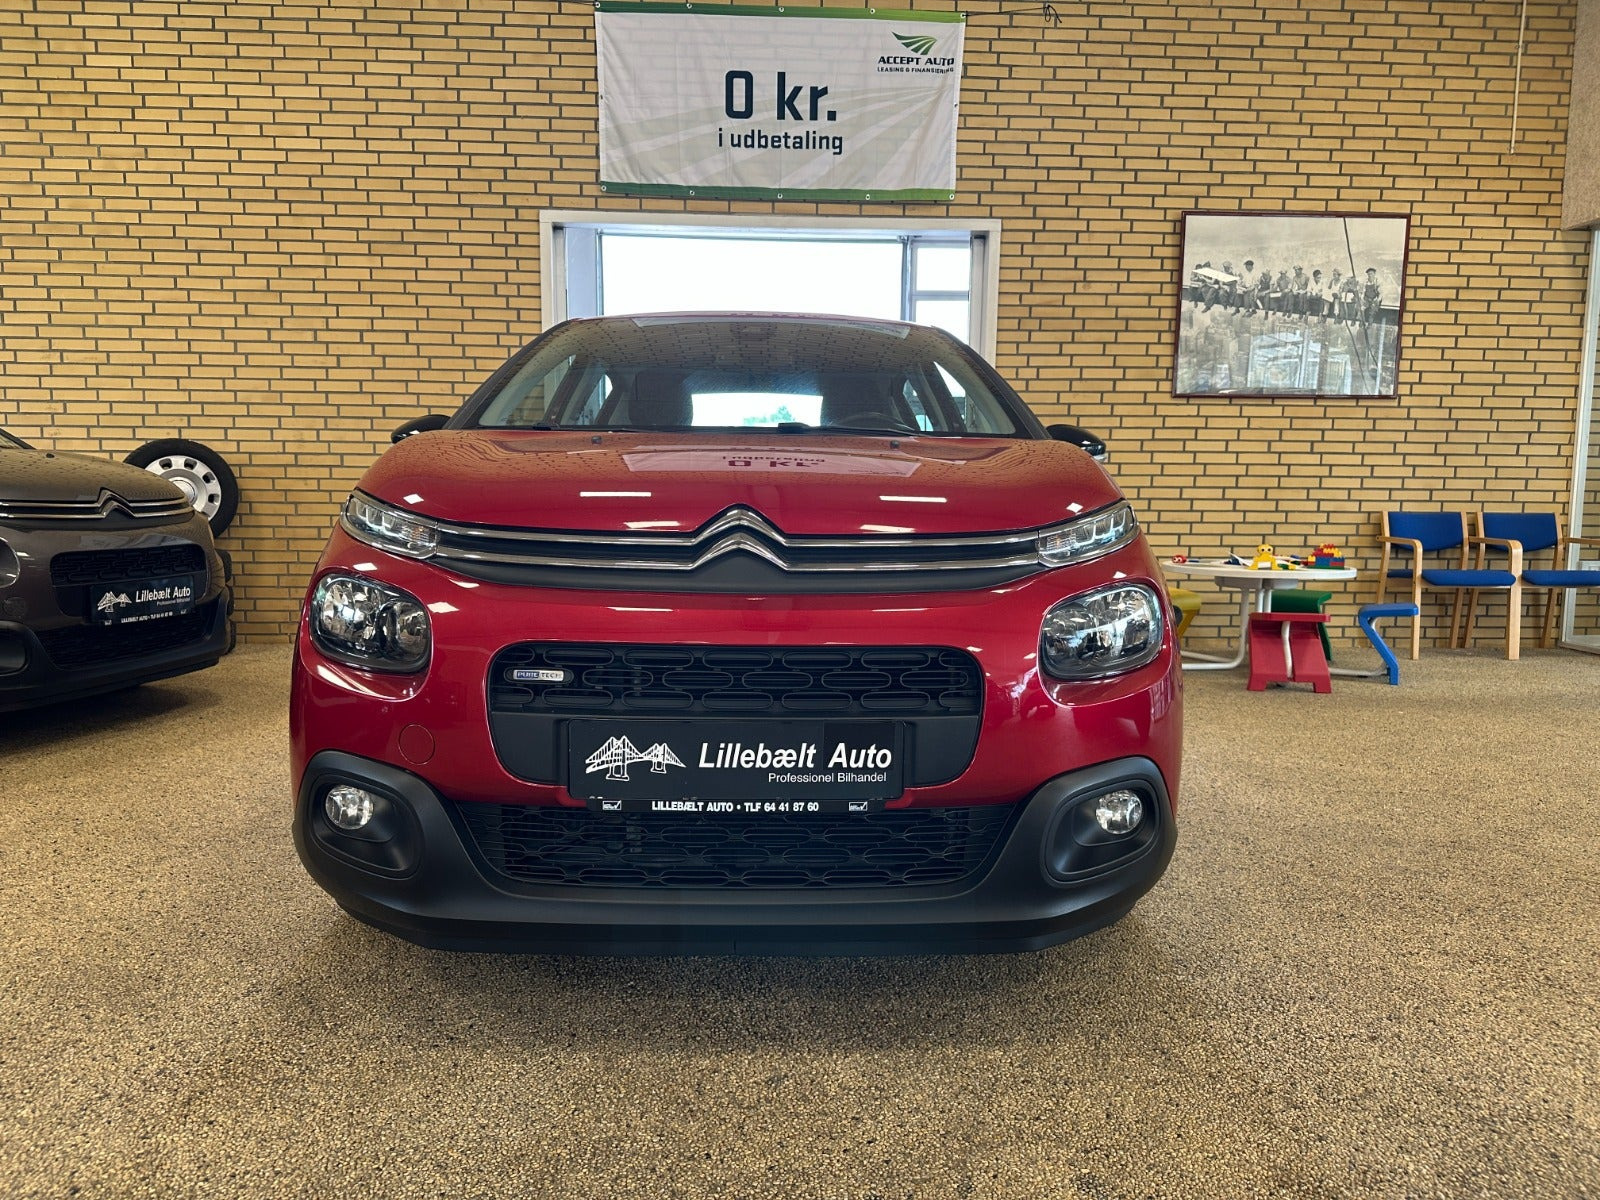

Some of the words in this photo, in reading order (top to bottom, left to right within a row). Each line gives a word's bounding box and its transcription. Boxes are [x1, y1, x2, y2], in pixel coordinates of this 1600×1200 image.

[878, 56, 921, 65] ACCEPT
[925, 57, 955, 66] AUTO
[725, 70, 754, 120] 0
[776, 71, 837, 121] kr.
[718, 127, 723, 148] i
[730, 129, 843, 156] udbetaling
[135, 588, 171, 602] Lillebælt
[173, 586, 190, 598] Auto
[516, 671, 539, 679] PURE
[699, 742, 817, 769] Lillebælt
[827, 742, 893, 769] Auto
[768, 772, 835, 783] Professionel
[837, 771, 887, 783] Bilhandel
[651, 800, 704, 812] LILLEBÆLT
[706, 802, 734, 812] AUTO
[744, 802, 762, 812] TLF
[764, 802, 776, 812] 64
[778, 802, 789, 812] 41
[793, 802, 805, 812] 87
[807, 801, 819, 812] 60
